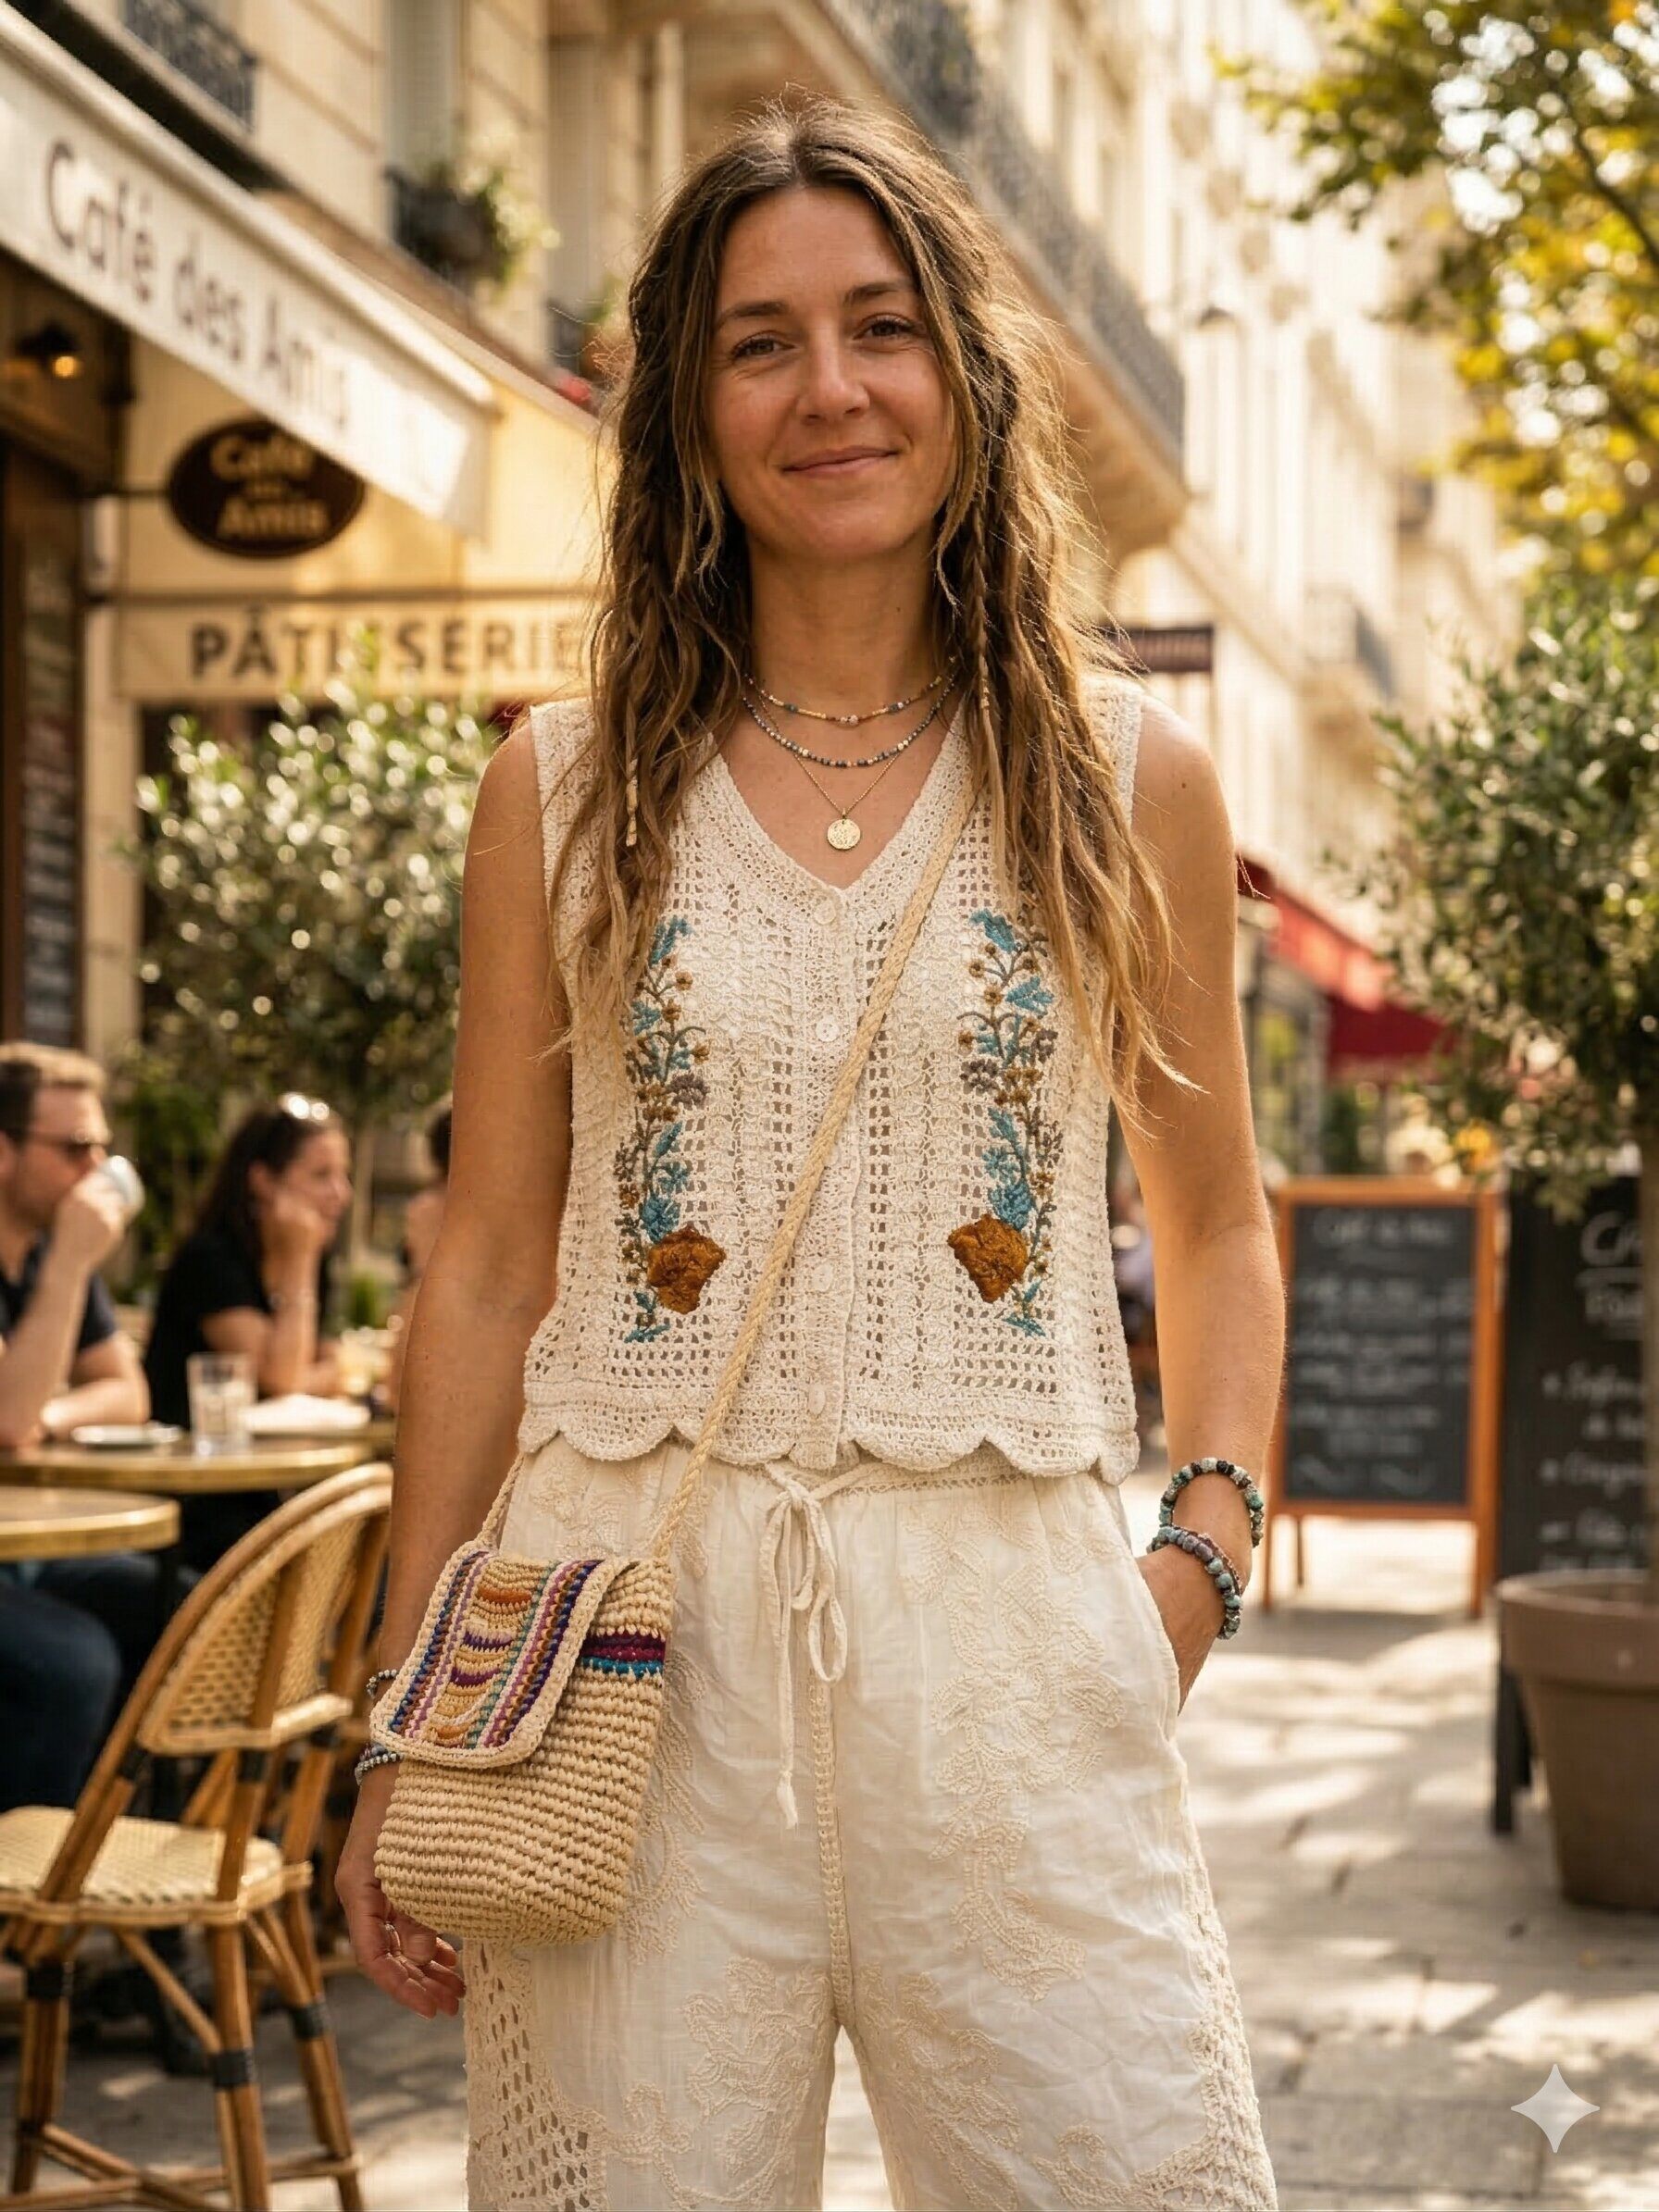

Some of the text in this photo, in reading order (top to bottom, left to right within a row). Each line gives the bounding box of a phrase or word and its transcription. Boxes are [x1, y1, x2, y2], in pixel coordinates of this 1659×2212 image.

[48, 141, 154, 304] Café
[173, 233, 245, 363] des
[191, 606, 580, 679] PÂTISERIE
